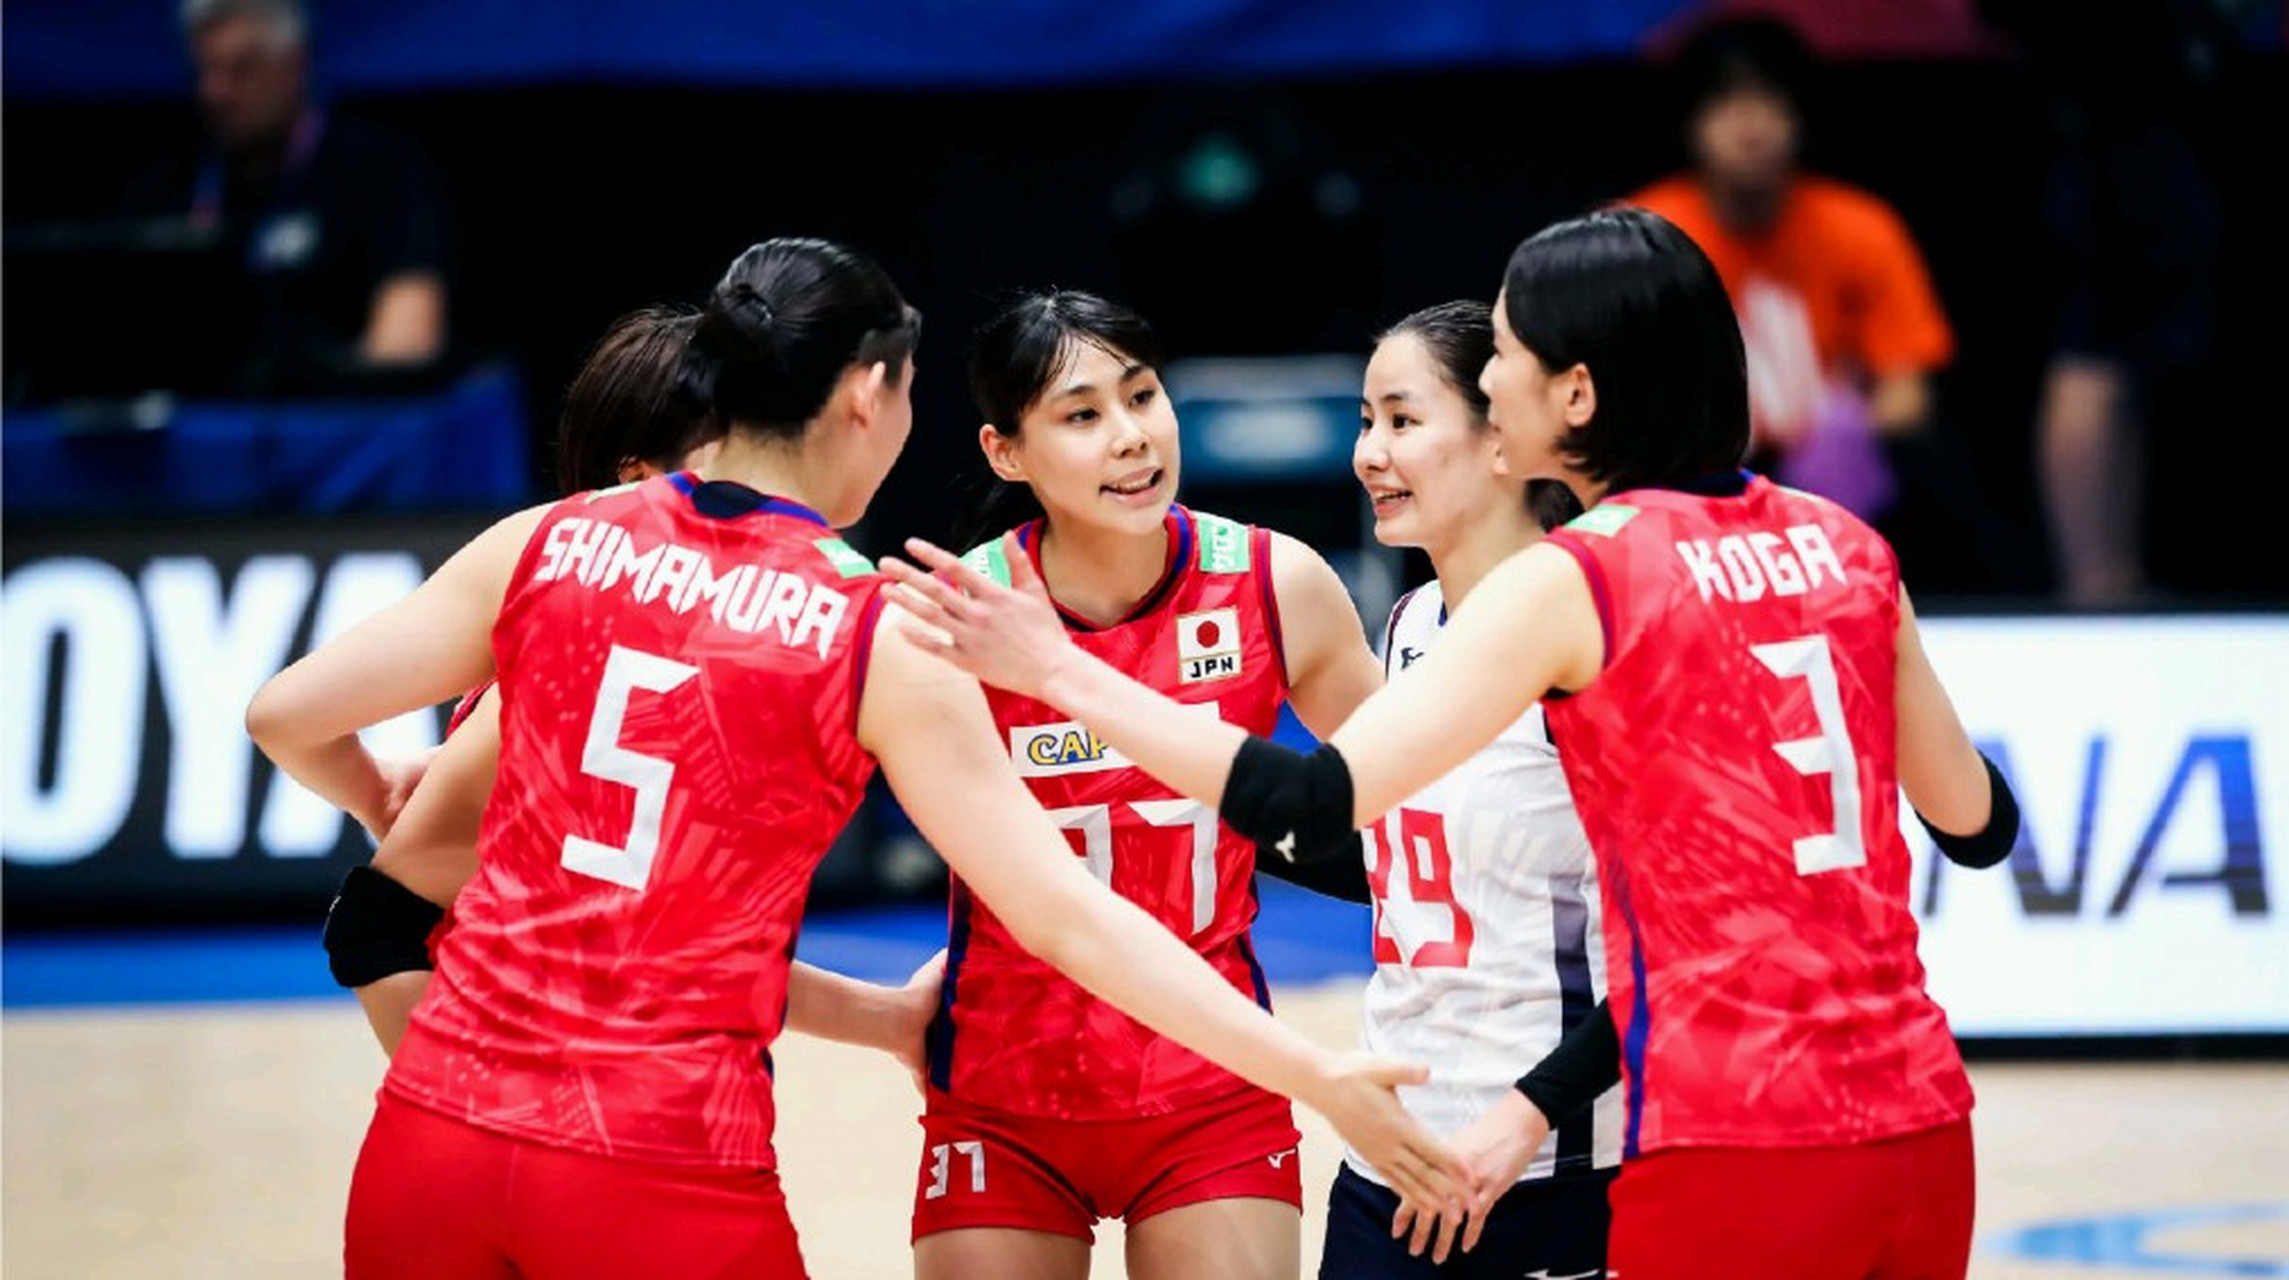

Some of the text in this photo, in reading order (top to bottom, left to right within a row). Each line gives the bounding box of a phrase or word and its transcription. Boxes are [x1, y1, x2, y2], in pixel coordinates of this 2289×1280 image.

[534, 517, 850, 661] SHIMAMURA
[1676, 523, 1848, 603] KOGA
[1190, 656, 1233, 678] JPN
[560, 643, 701, 892] 5
[1749, 633, 1867, 876] 3
[925, 1141, 986, 1199] 37
